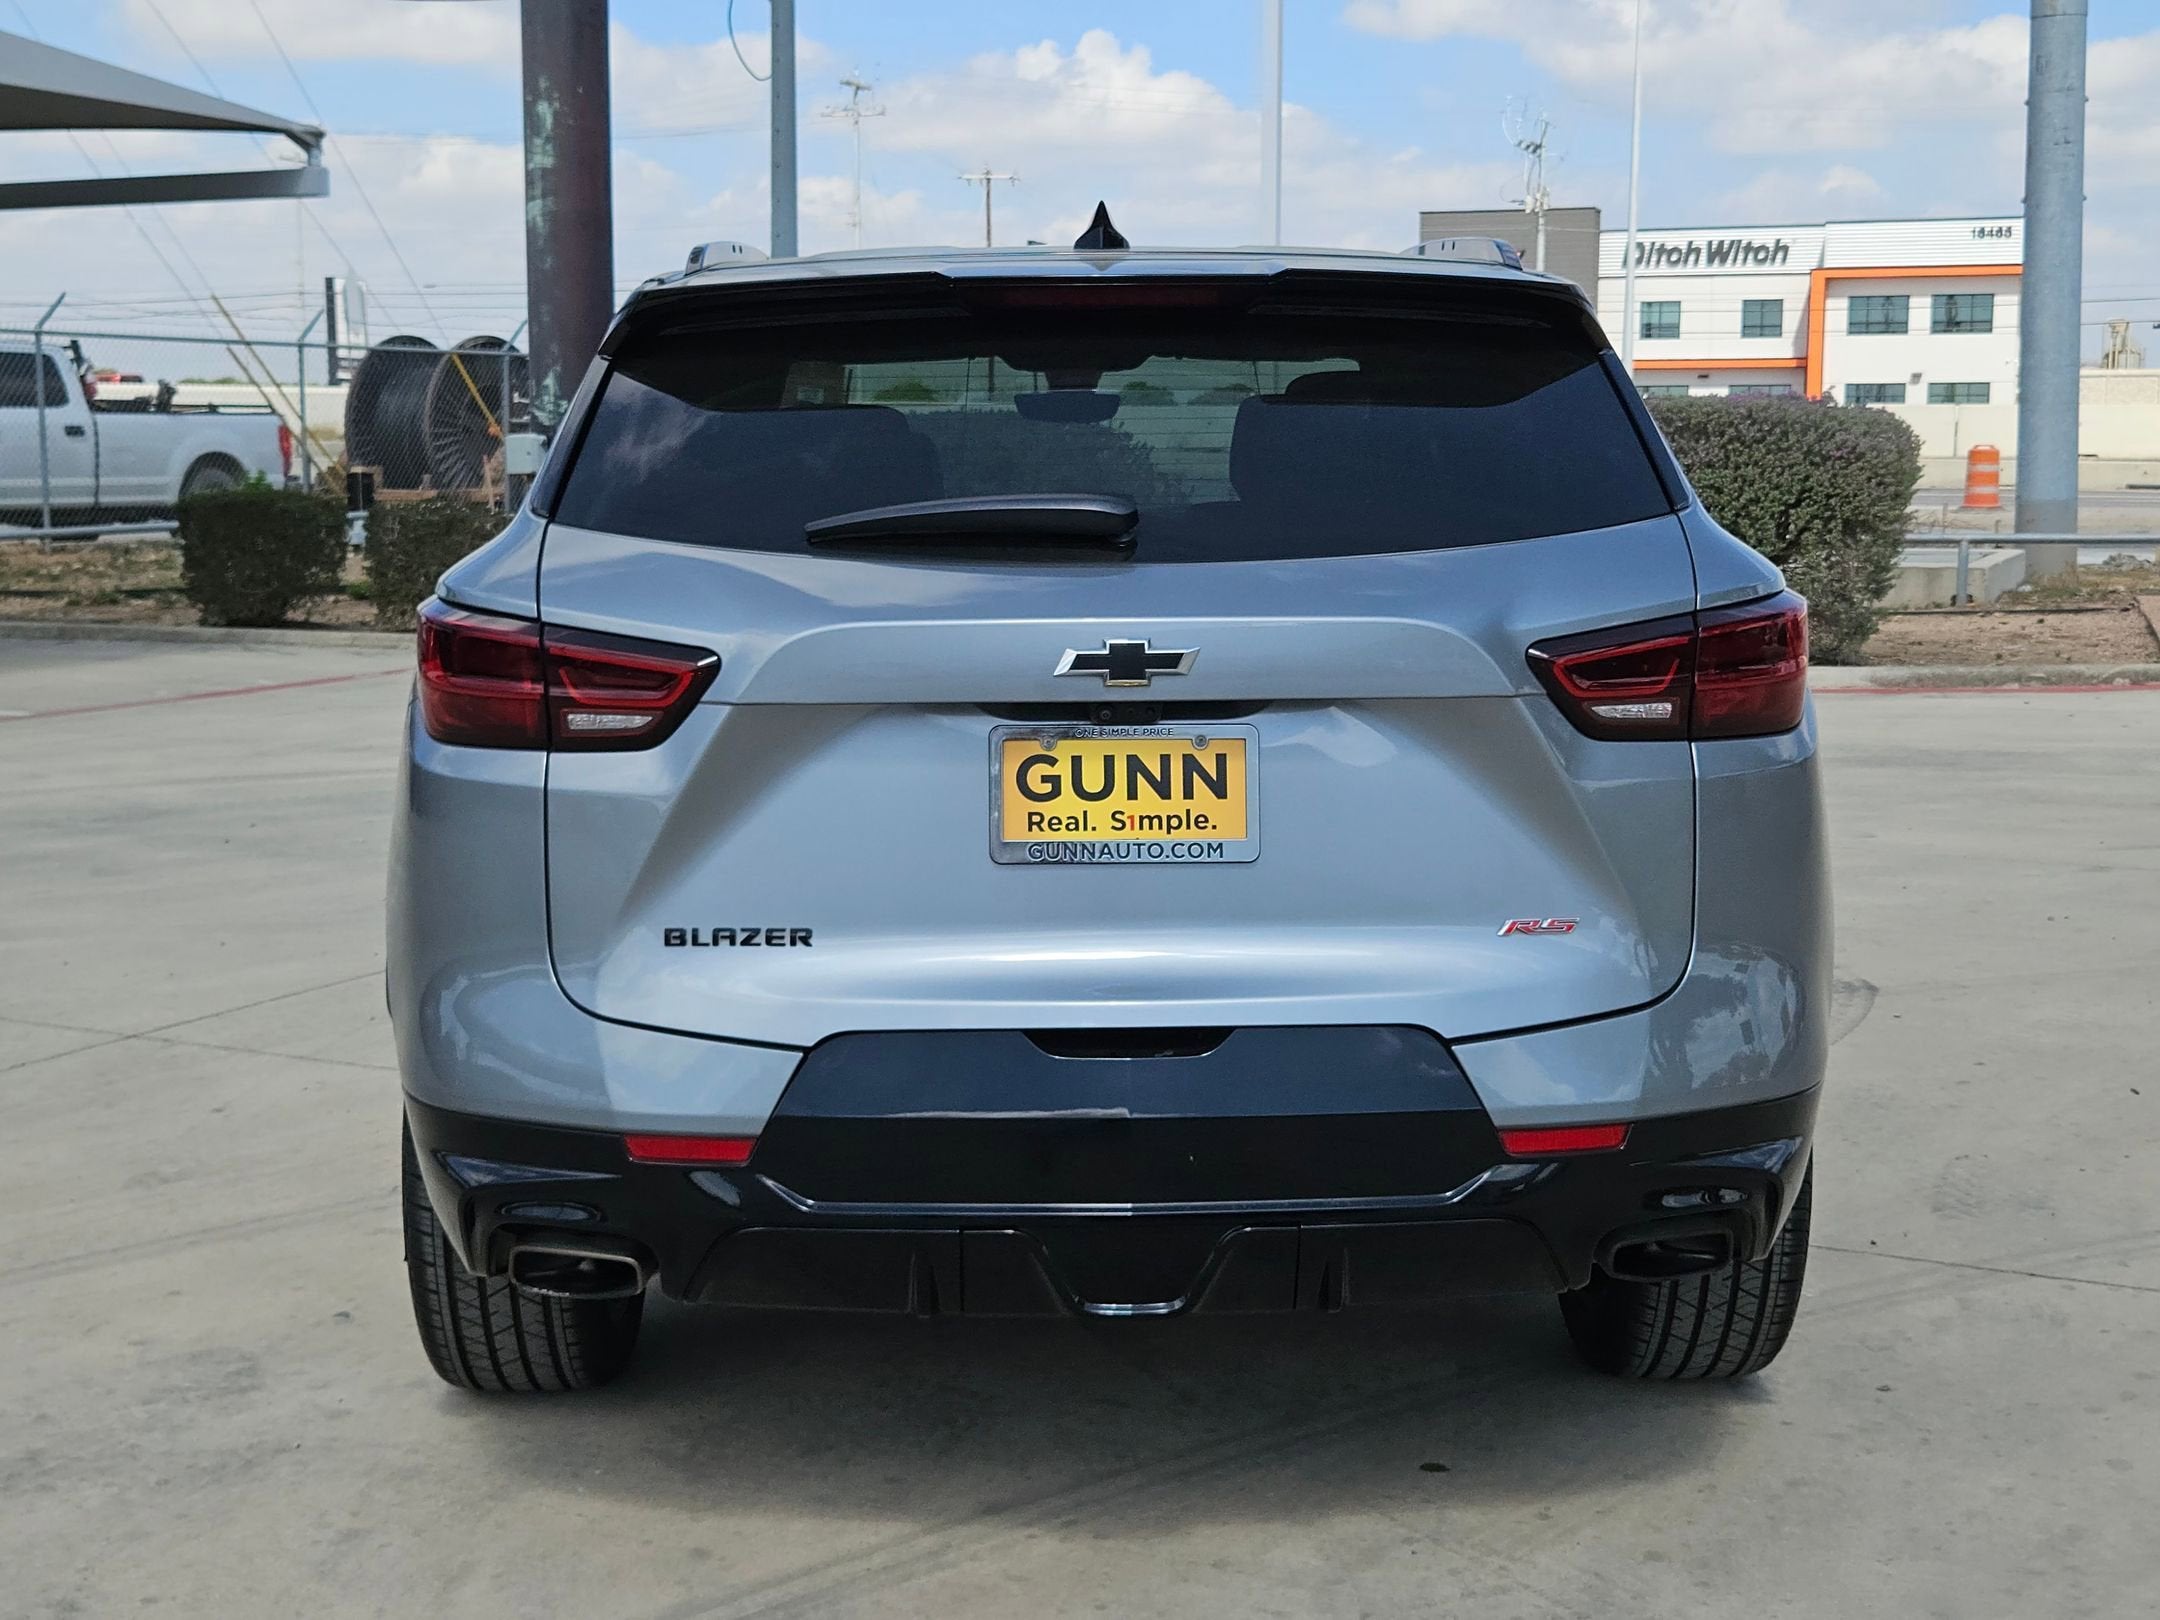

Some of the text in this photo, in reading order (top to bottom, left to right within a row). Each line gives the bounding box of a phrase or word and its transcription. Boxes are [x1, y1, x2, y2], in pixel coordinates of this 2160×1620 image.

[1623, 238, 1790, 269] Ditch Witch
[1075, 728, 1174, 737] ONE SIMPLE PRICE
[1016, 752, 1228, 803] GUNN
[1027, 810, 1097, 832] Real.
[1027, 842, 1224, 862] GUNNAUTO.COM
[1497, 917, 1580, 936] RS
[664, 927, 813, 947] BLAZER
